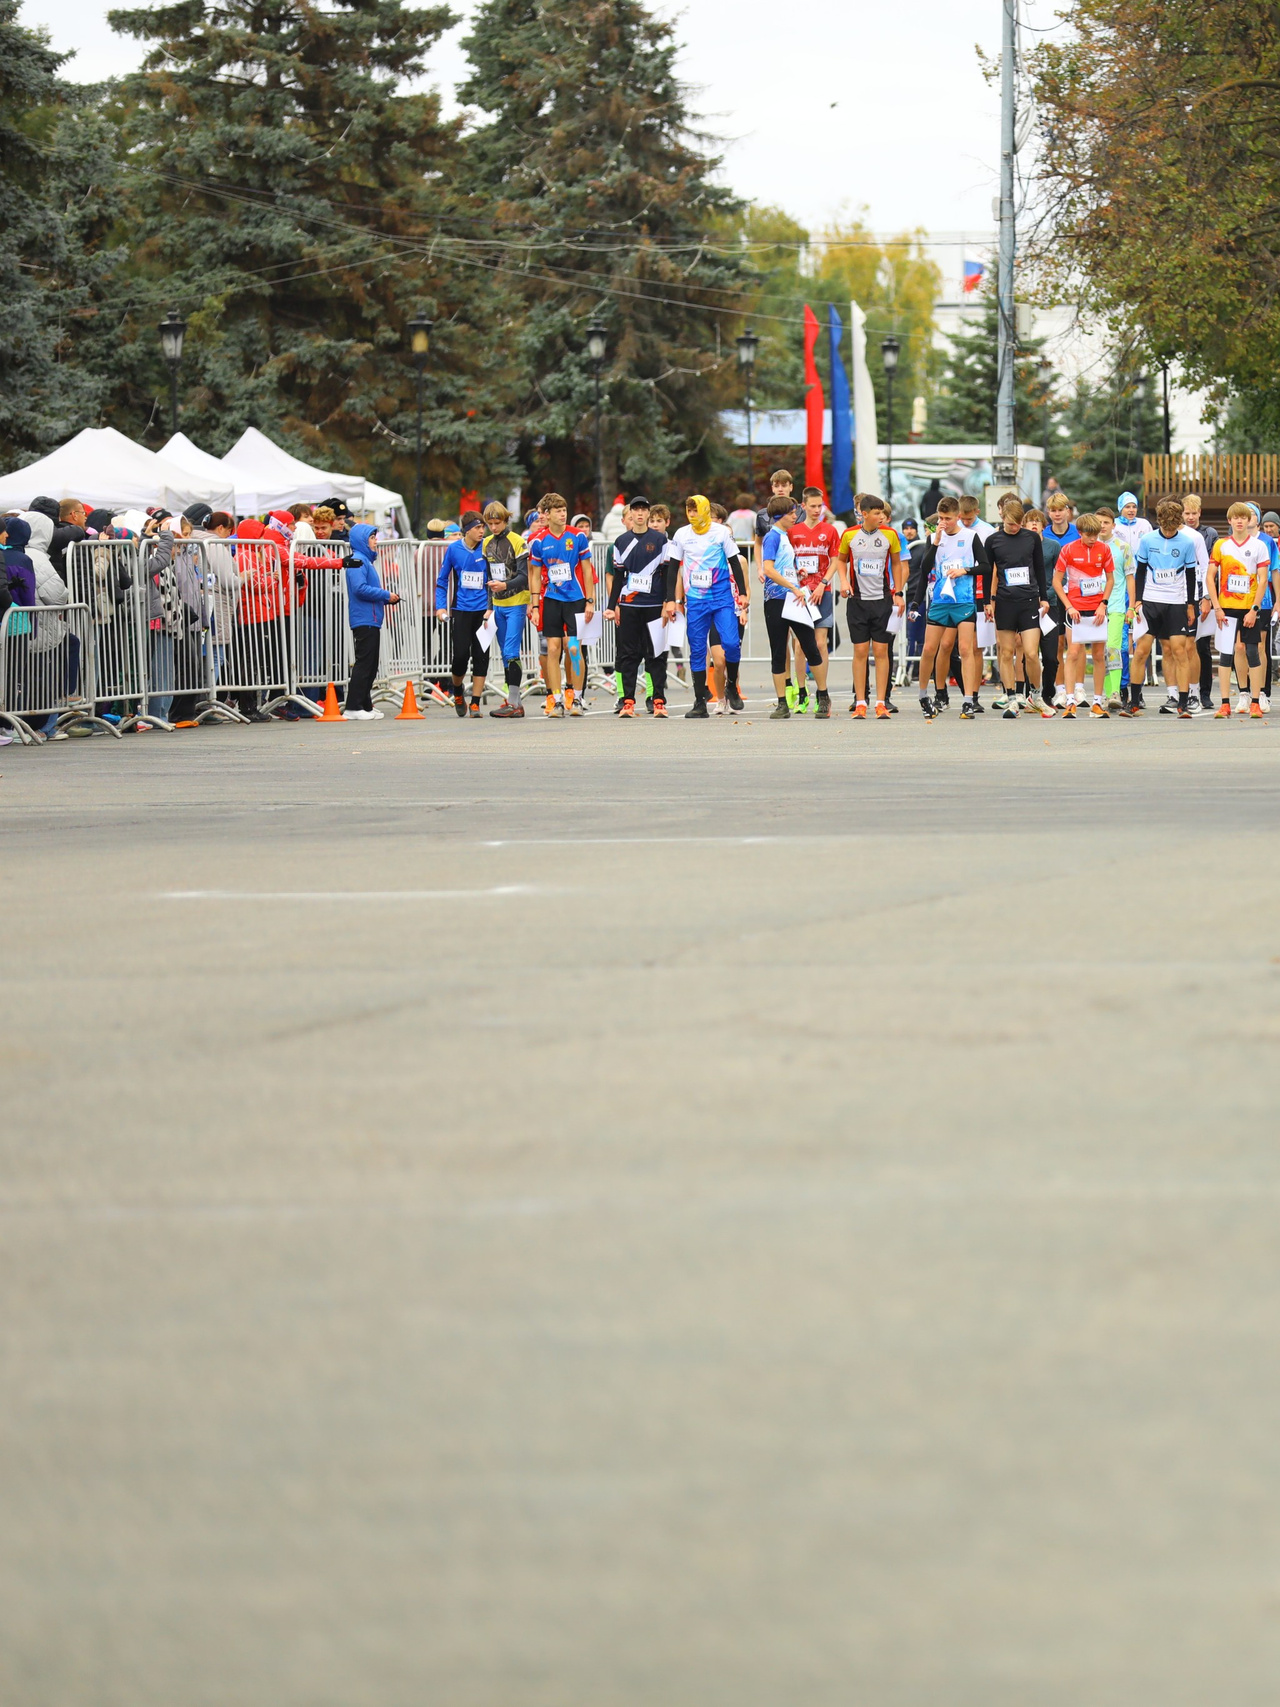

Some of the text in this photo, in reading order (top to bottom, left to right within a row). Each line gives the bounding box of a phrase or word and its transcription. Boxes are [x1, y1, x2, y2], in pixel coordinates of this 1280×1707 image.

[551, 568, 567, 577] 302.1
[463, 574, 480, 582] 321.1
[632, 577, 648, 585] 303.1
[1083, 582, 1100, 590] 309.1
